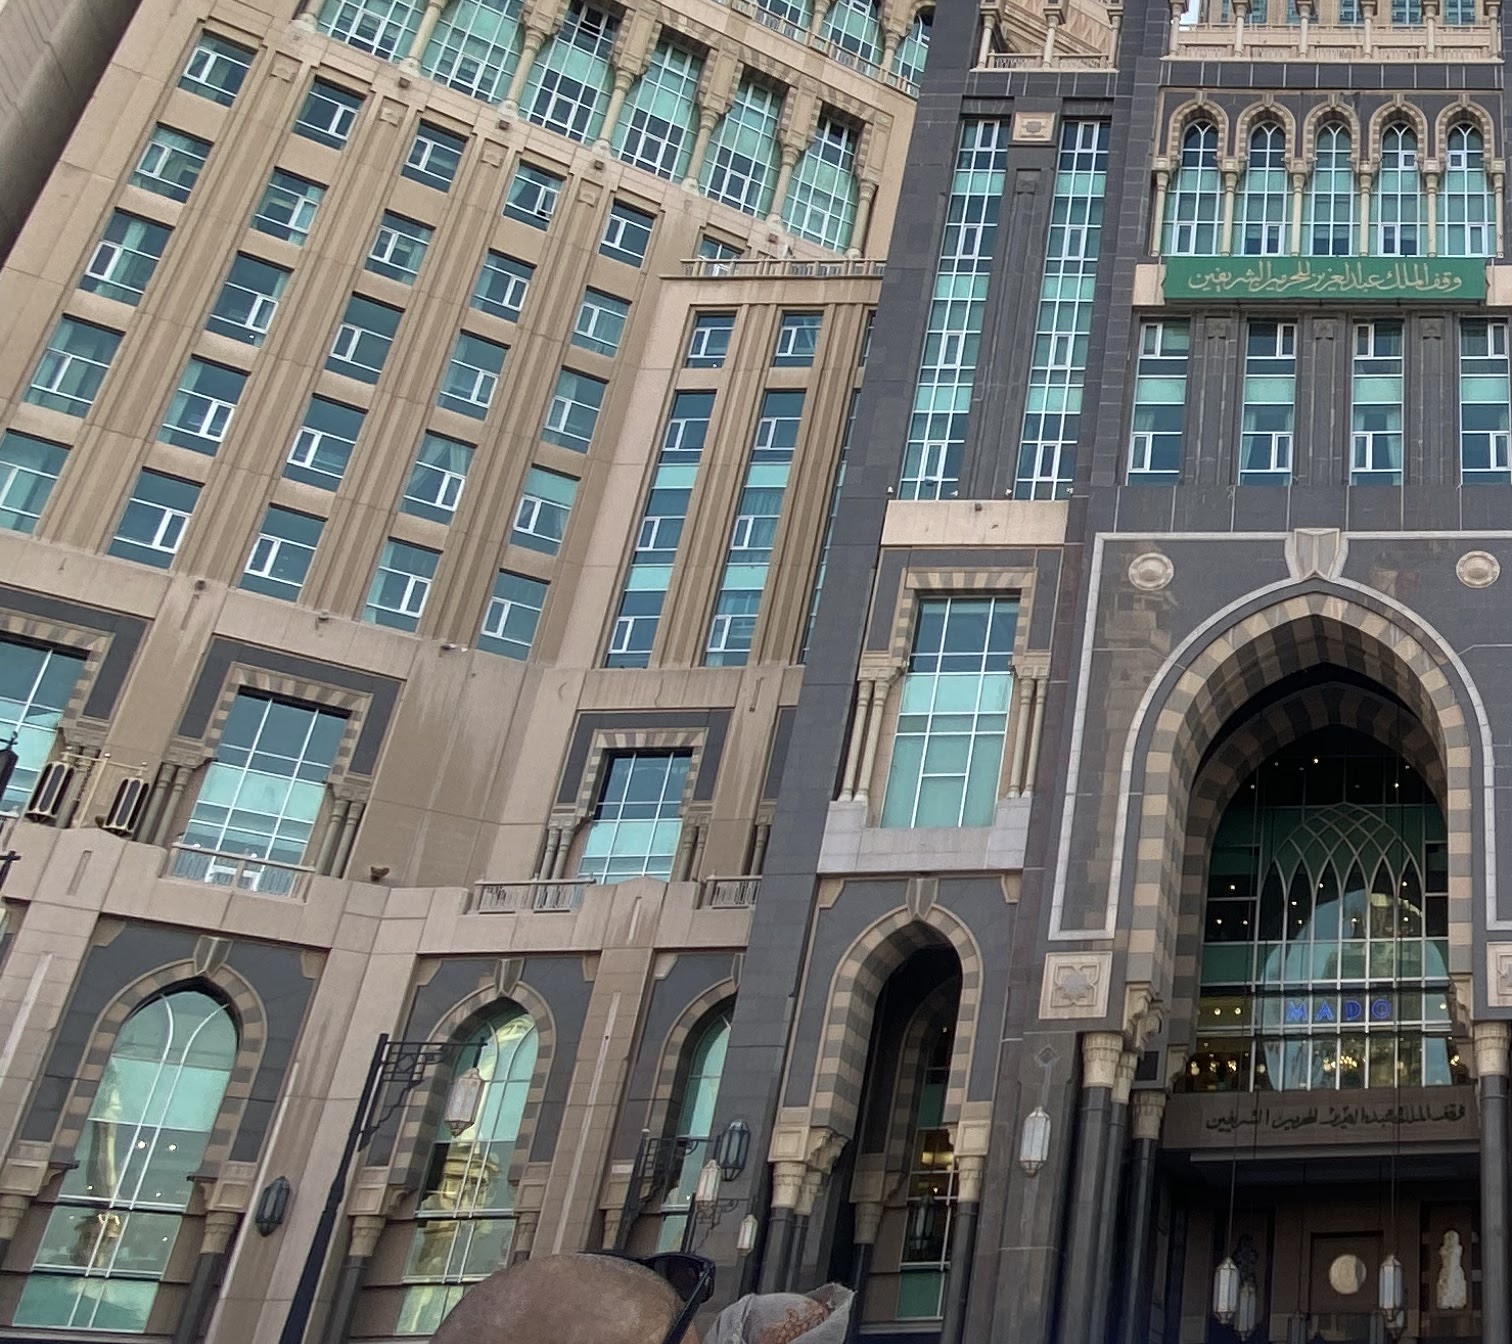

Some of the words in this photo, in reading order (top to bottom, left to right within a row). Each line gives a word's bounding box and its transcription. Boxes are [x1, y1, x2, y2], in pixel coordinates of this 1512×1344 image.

[1376, 262, 1429, 291] الملك
[1416, 272, 1462, 293] وقف
[1285, 998, 1392, 1022] MADO
